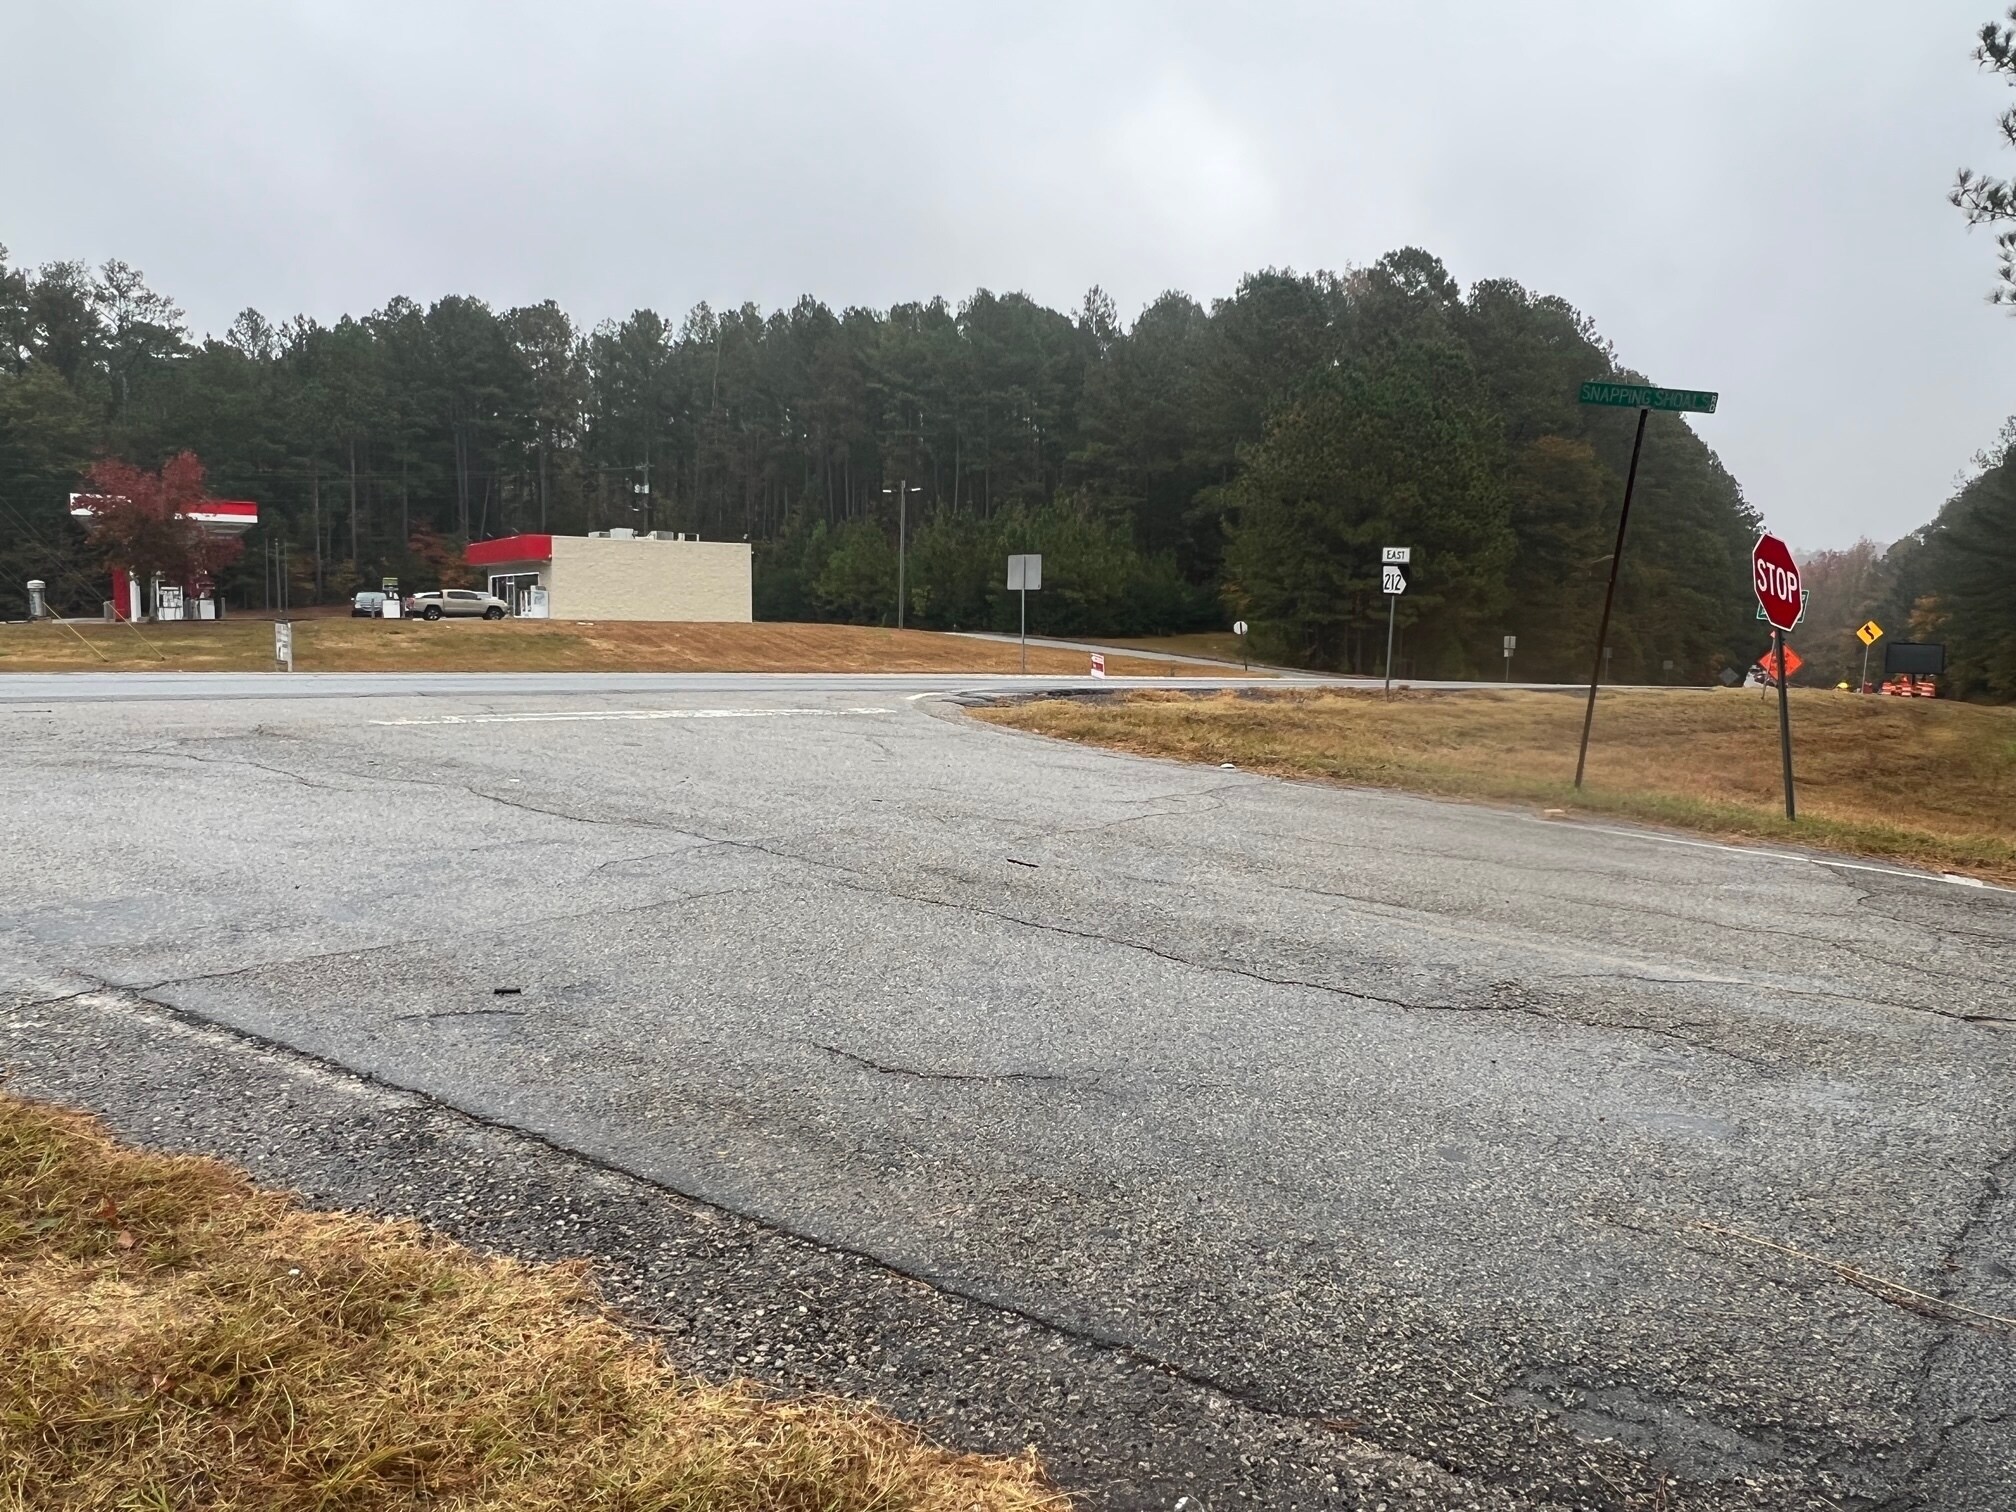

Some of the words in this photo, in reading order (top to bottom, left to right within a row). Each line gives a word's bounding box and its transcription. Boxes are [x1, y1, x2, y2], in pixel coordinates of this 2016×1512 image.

[1581, 384, 1651, 405] SNAPPING
[1654, 391, 1709, 409] SHOALS
[1386, 549, 1405, 559] EAST
[1384, 573, 1402, 591] 212
[1757, 558, 1798, 603] STOP
